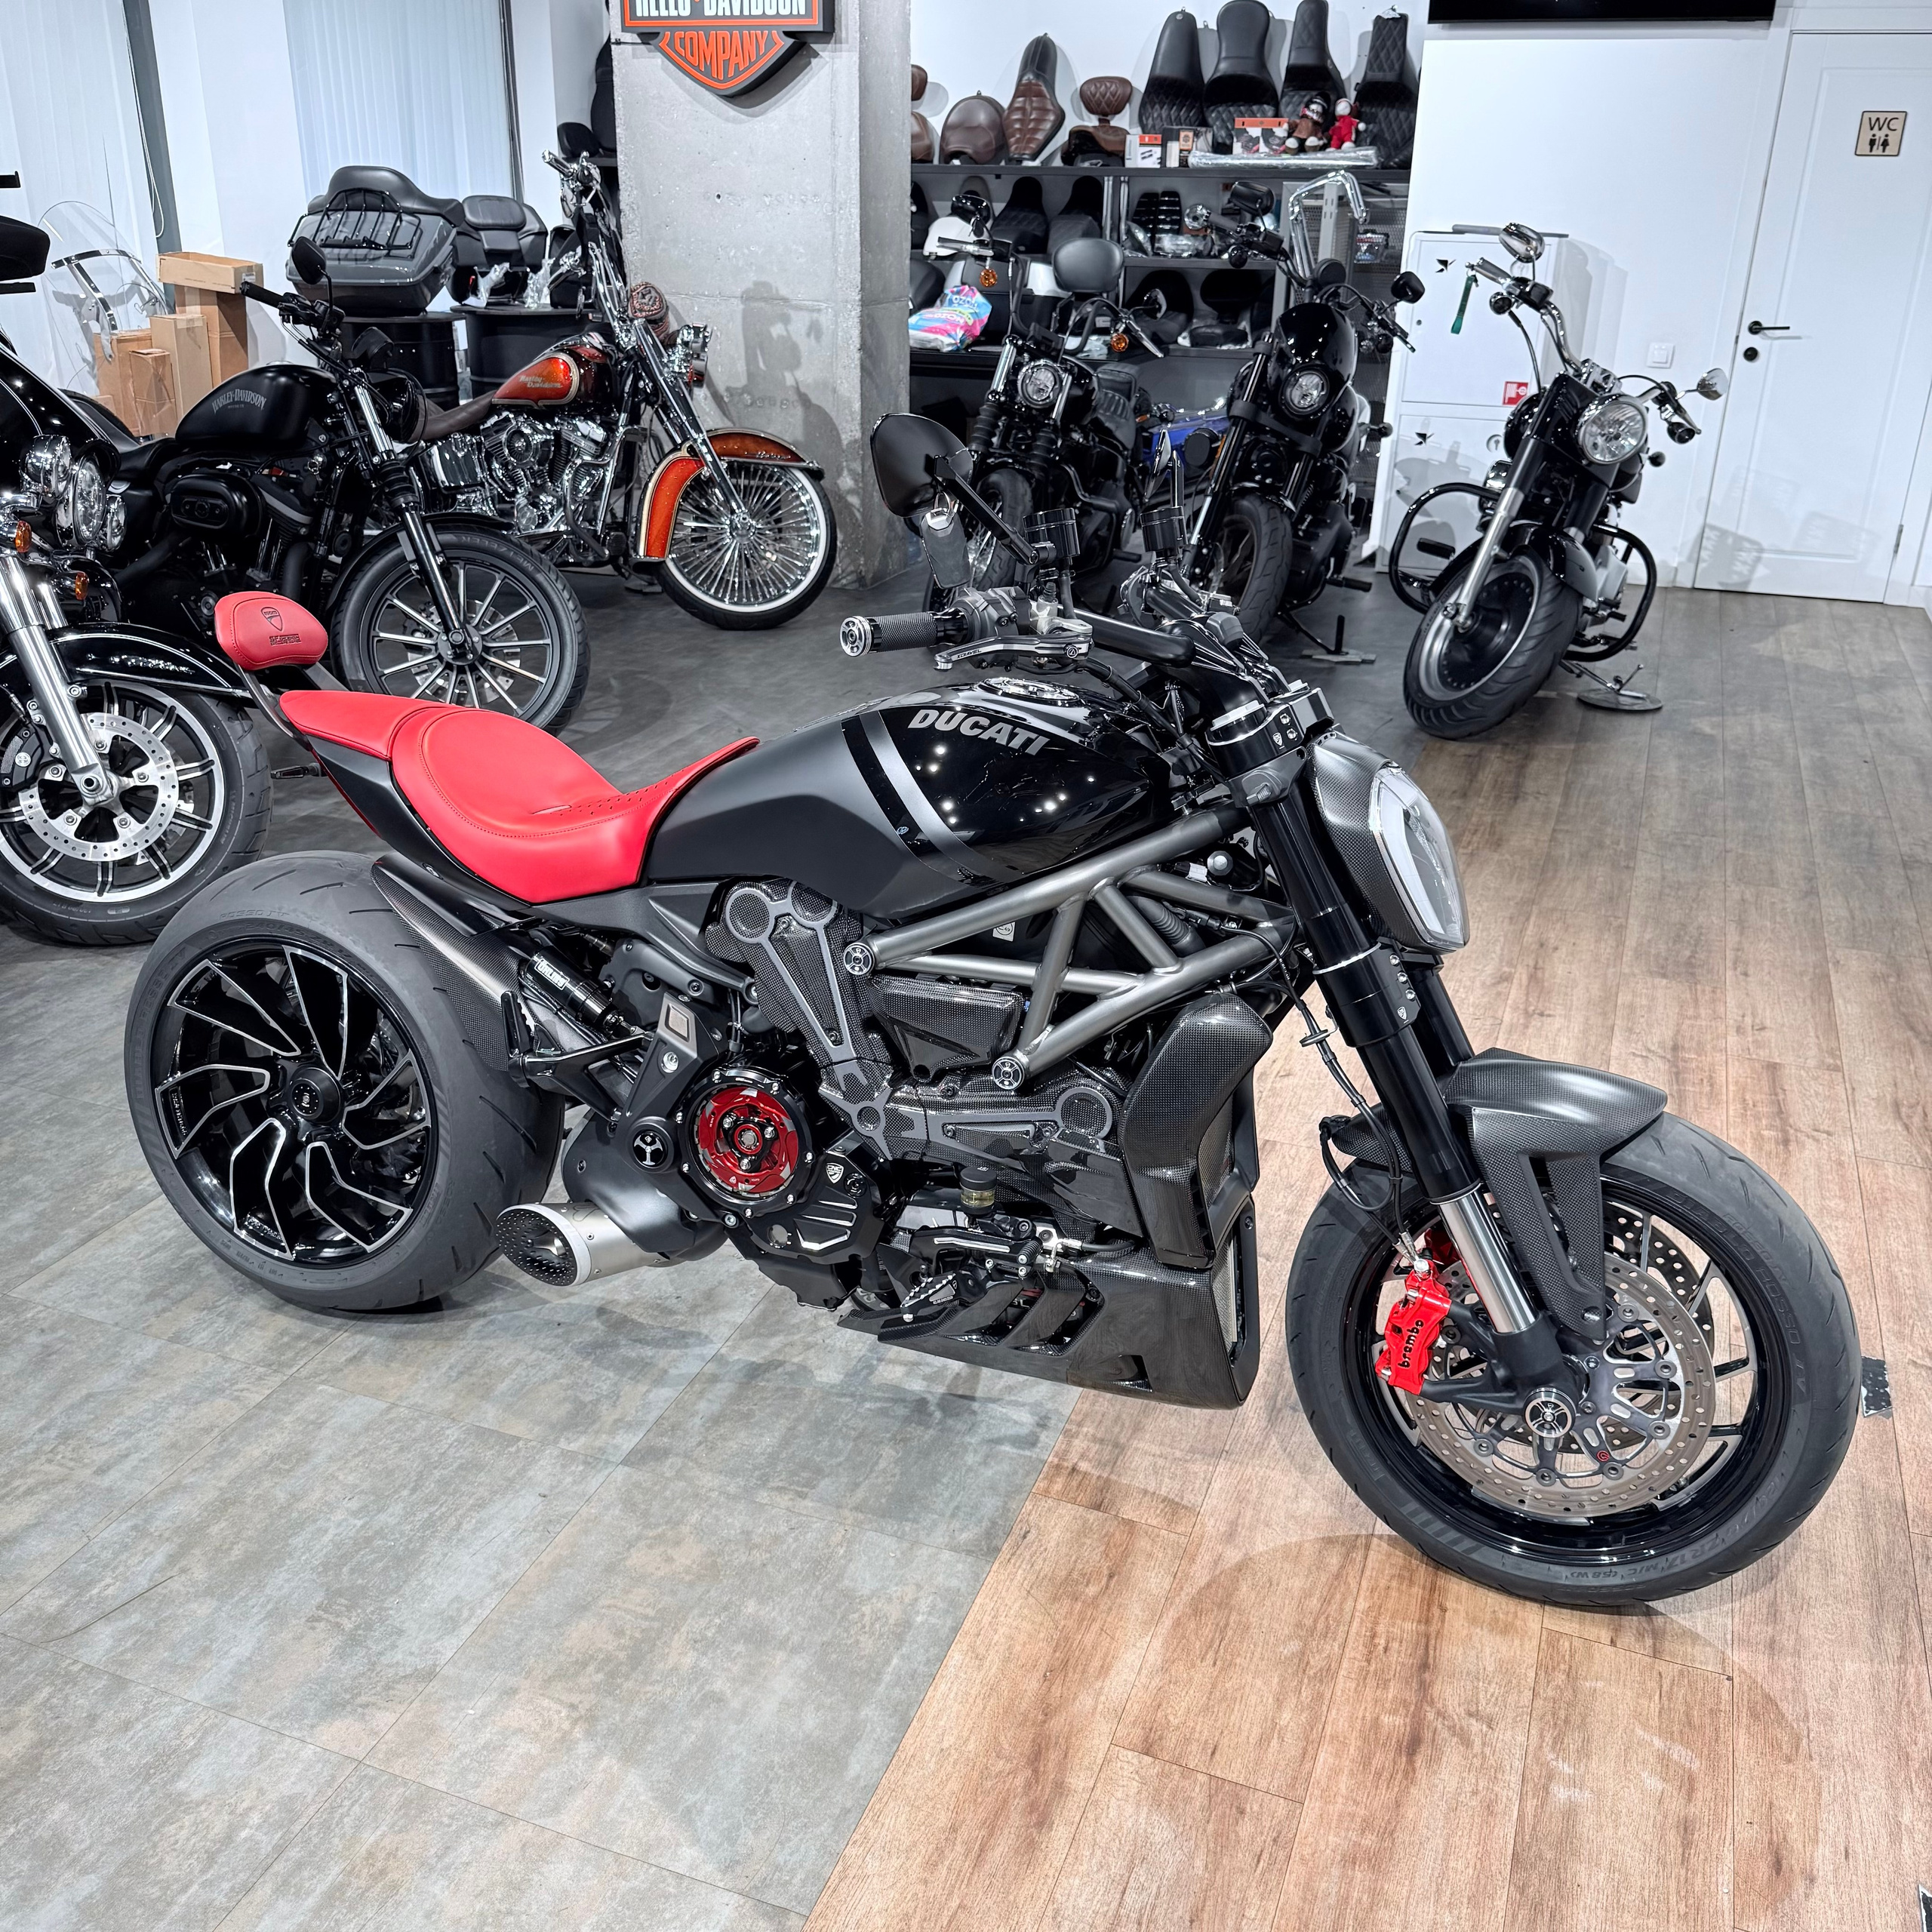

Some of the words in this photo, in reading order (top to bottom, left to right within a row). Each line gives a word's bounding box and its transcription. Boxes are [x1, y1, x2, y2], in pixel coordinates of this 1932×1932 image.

[674, 30, 768, 81] COMPANY
[1869, 117, 1899, 131] WC
[908, 709, 1051, 755] DUCATI
[1397, 1319, 1425, 1369] brembo
